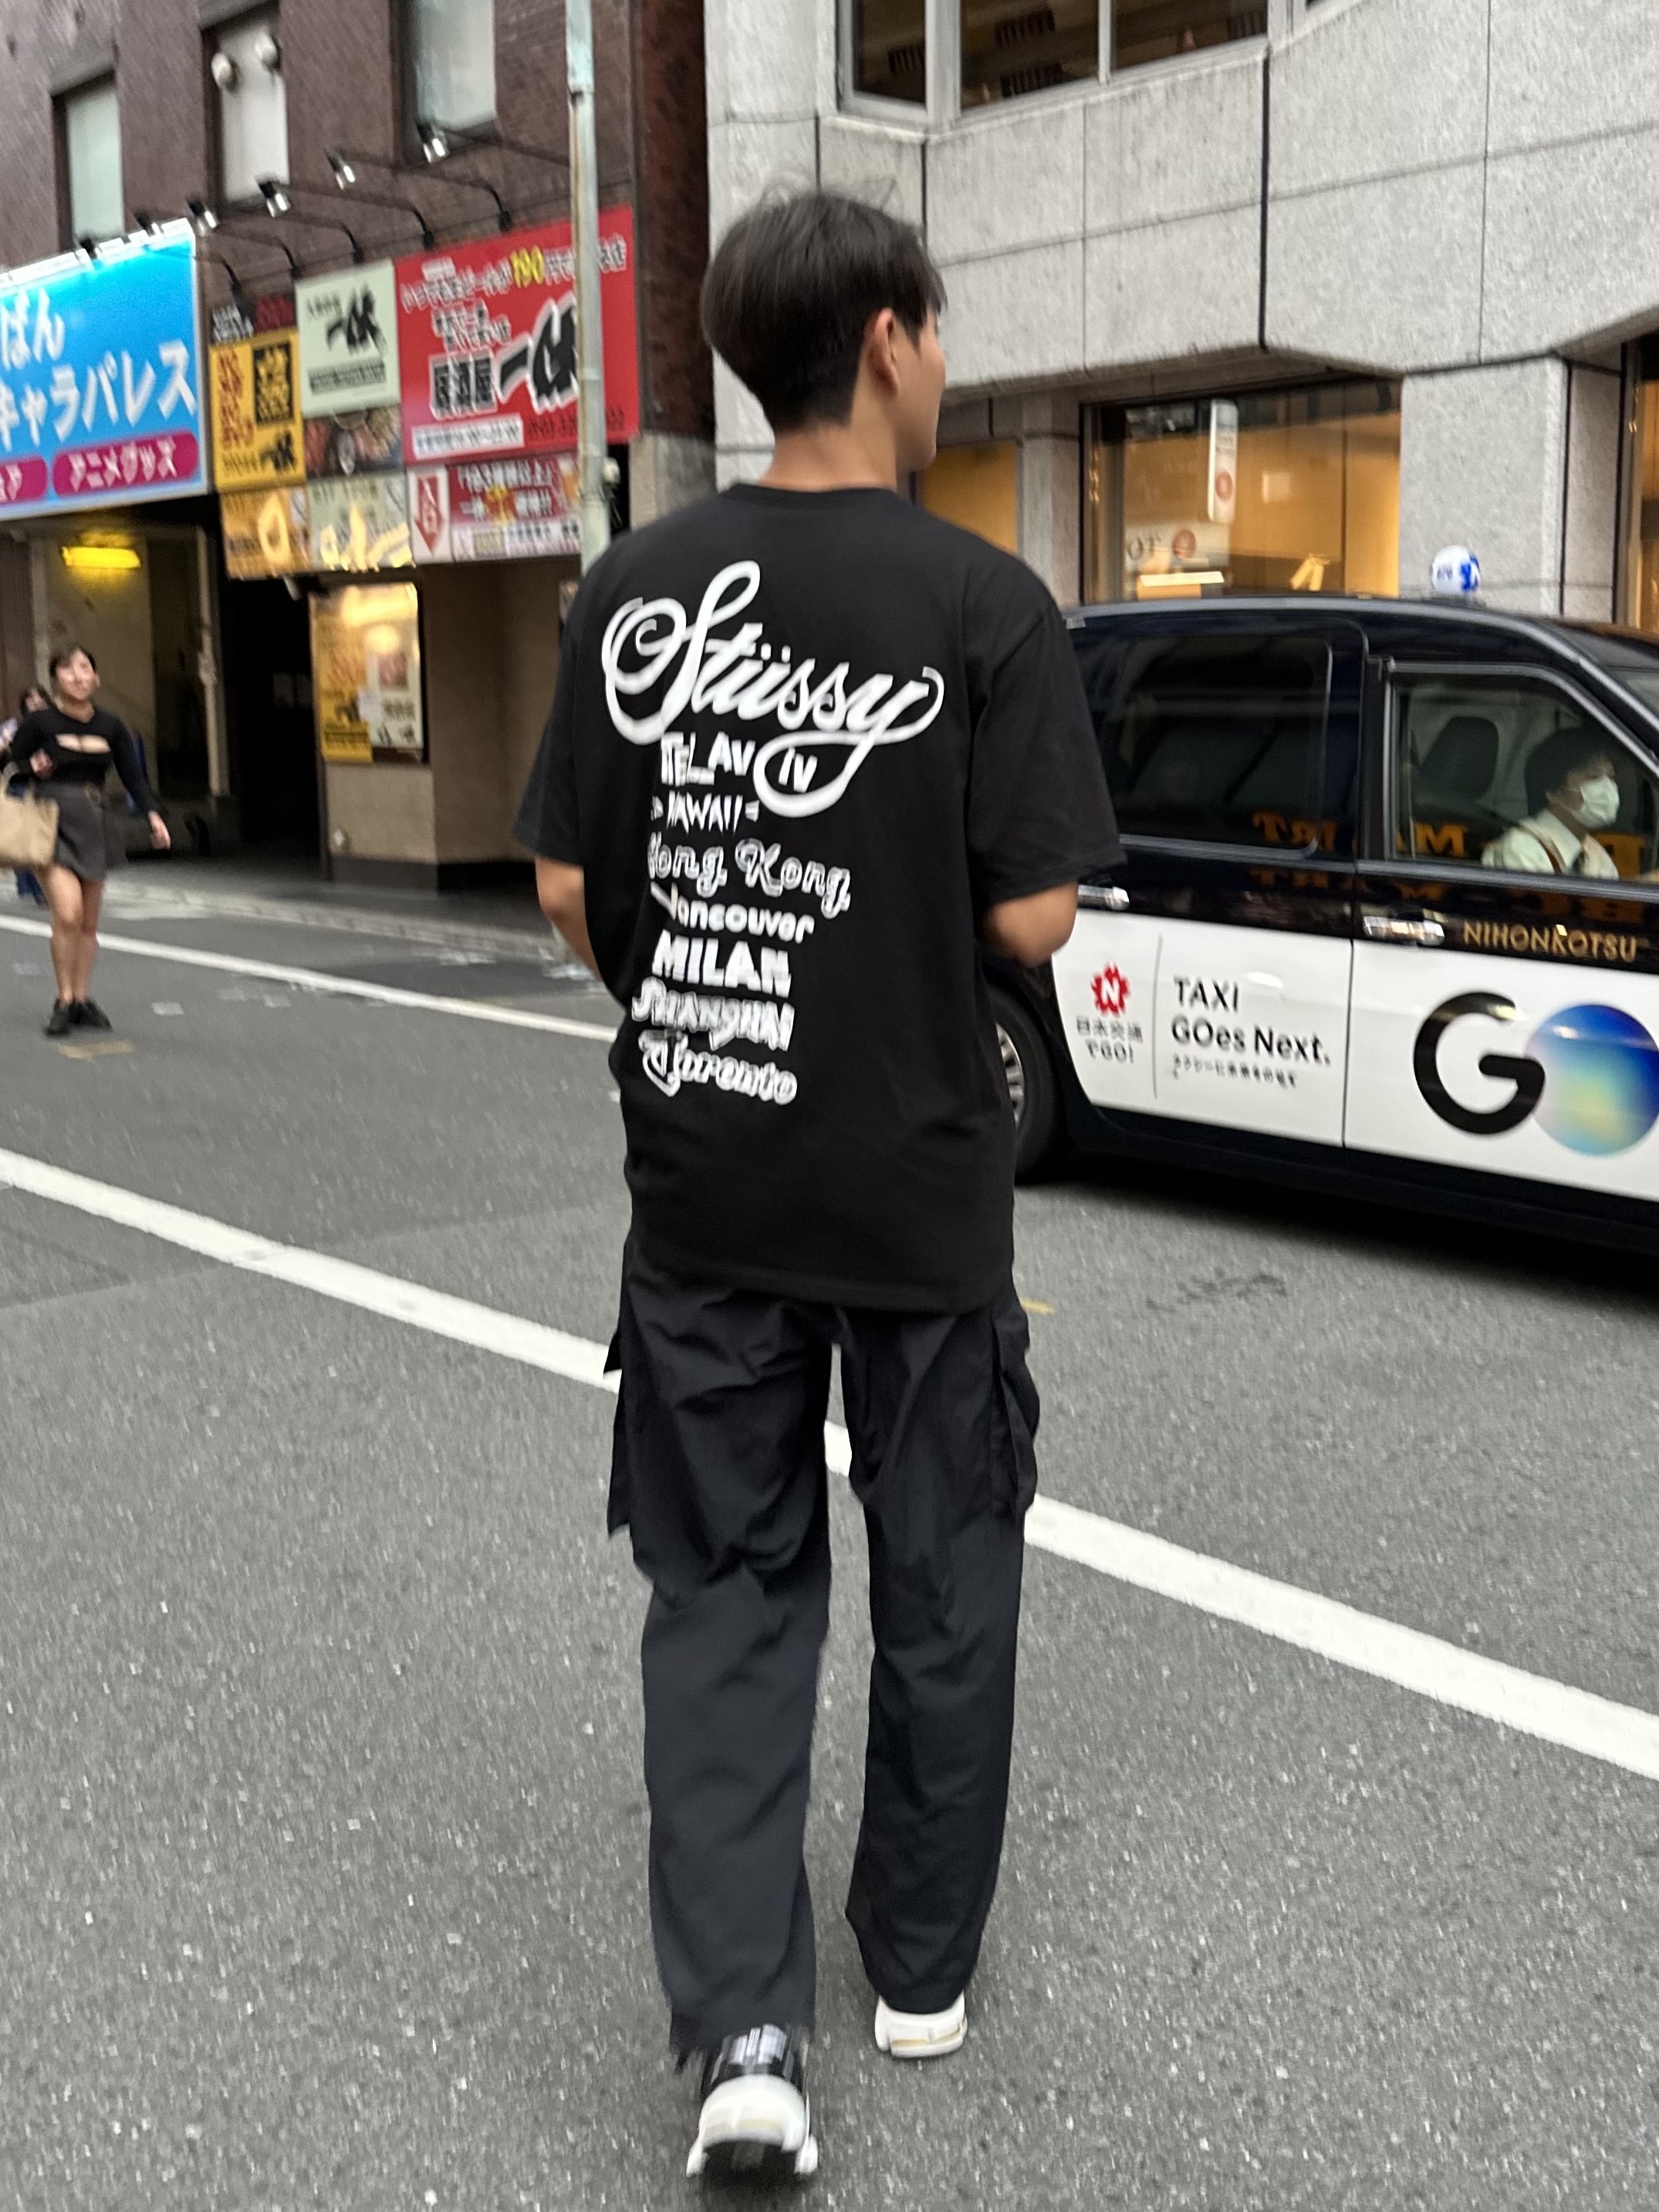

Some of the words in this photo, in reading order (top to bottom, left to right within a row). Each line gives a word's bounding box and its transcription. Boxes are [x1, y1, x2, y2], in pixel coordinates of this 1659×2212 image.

[602, 560, 944, 817] Stüssy
[735, 837, 851, 919] Kong
[650, 881, 815, 944] Vancouver
[1463, 920, 1637, 963] NIHONKOTSU
[652, 928, 792, 999] MILAN
[1173, 974, 1238, 1013] TAXI
[638, 1029, 798, 1105] Toronto
[1171, 1013, 1246, 1053] GOes
[1253, 1023, 1331, 1066] Next.
